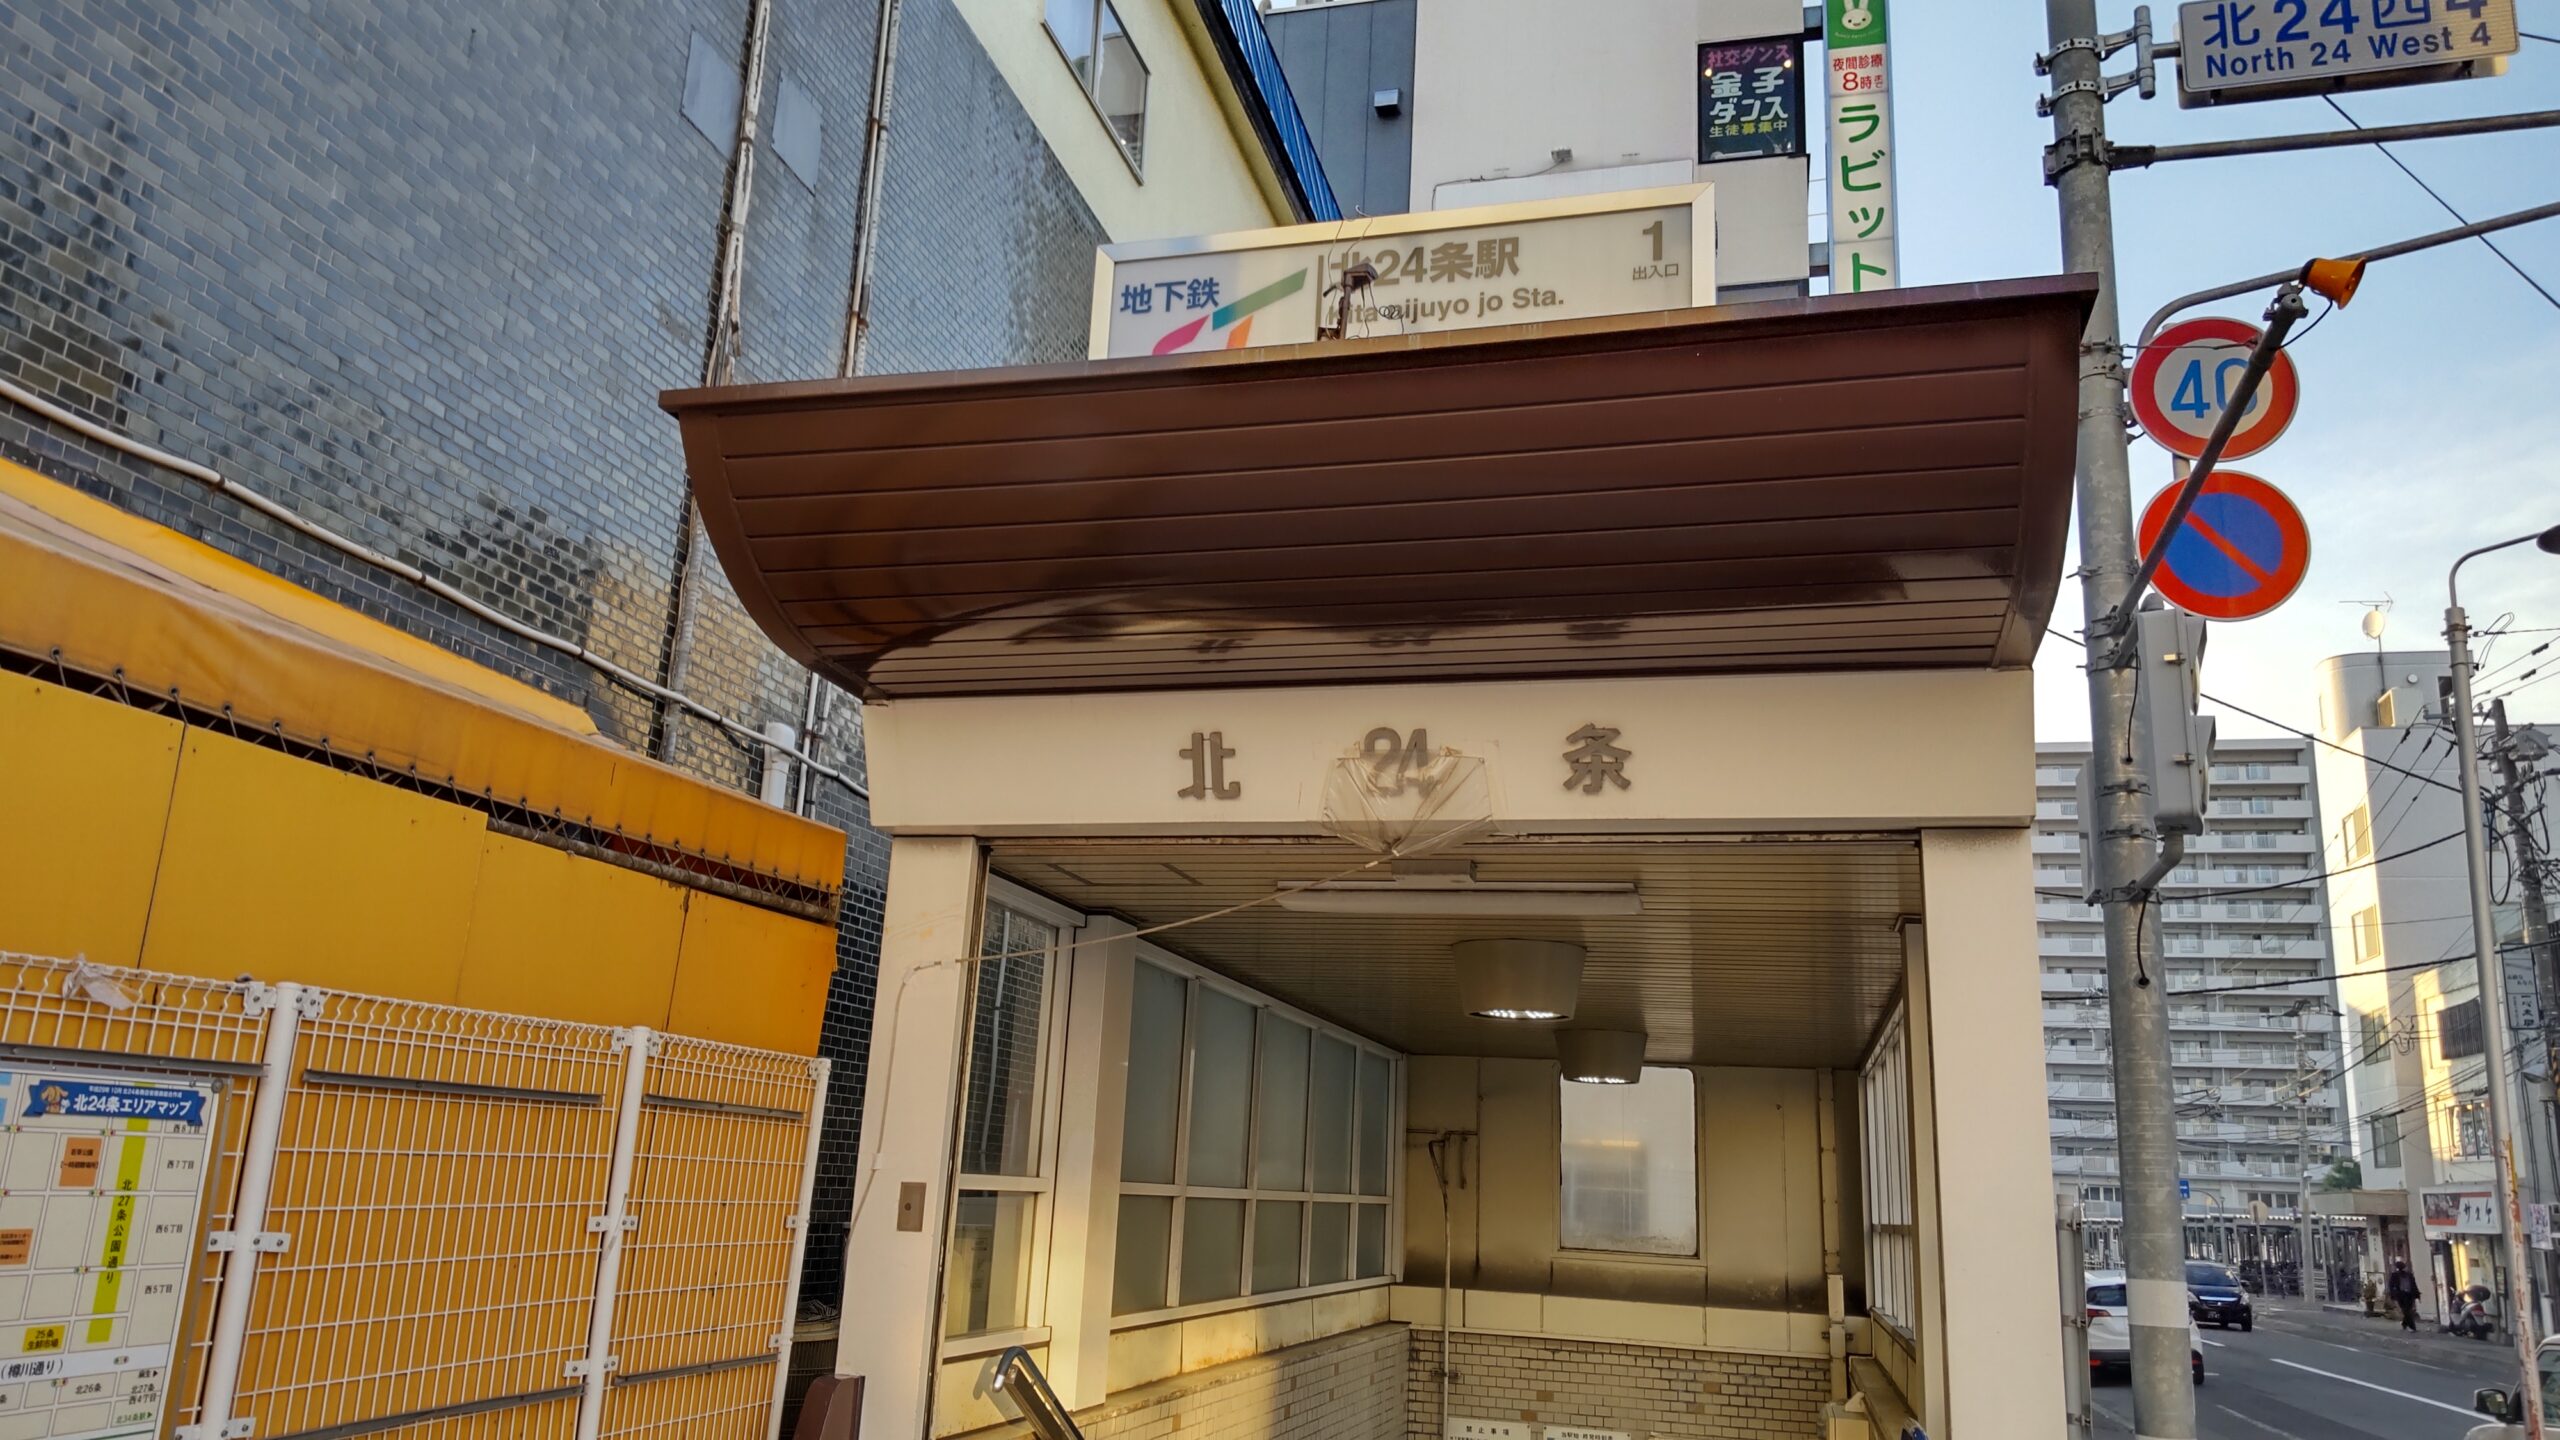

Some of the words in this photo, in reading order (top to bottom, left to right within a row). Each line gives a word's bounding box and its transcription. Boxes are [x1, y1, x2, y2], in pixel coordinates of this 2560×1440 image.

[1708, 44, 1790, 68] 社交ダンス
[1833, 53, 1883, 72] 夜間診療
[2206, 47, 2295, 79] North
[2310, 40, 2352, 67] 24
[2368, 26, 2454, 60] West
[2470, 21, 2492, 47] 4
[1710, 66, 1785, 98] 金子
[1709, 96, 1789, 125] ダンス
[1709, 119, 1788, 138] 生徒募集中
[1838, 103, 1888, 292] ラビット
[1642, 220, 1663, 261] 1
[1632, 262, 1680, 281] 出入口
[1119, 276, 1220, 314] 地下鉄
[1477, 291, 1504, 318] jo
[1512, 286, 1564, 309] Sta.
[2170, 357, 2258, 419] 40
[1178, 731, 1241, 800] 北
[1363, 726, 1436, 799] 24
[1562, 722, 1633, 795] 条
[73, 1093, 192, 1116] 北24条エリアマップ
[166, 1159, 195, 1170] 西7丁目
[106, 1178, 133, 1284] 北27条公園通り
[155, 1223, 184, 1234] 西6丁目
[144, 1284, 173, 1295] 西5丁目
[75, 1382, 102, 1395] 北26条
